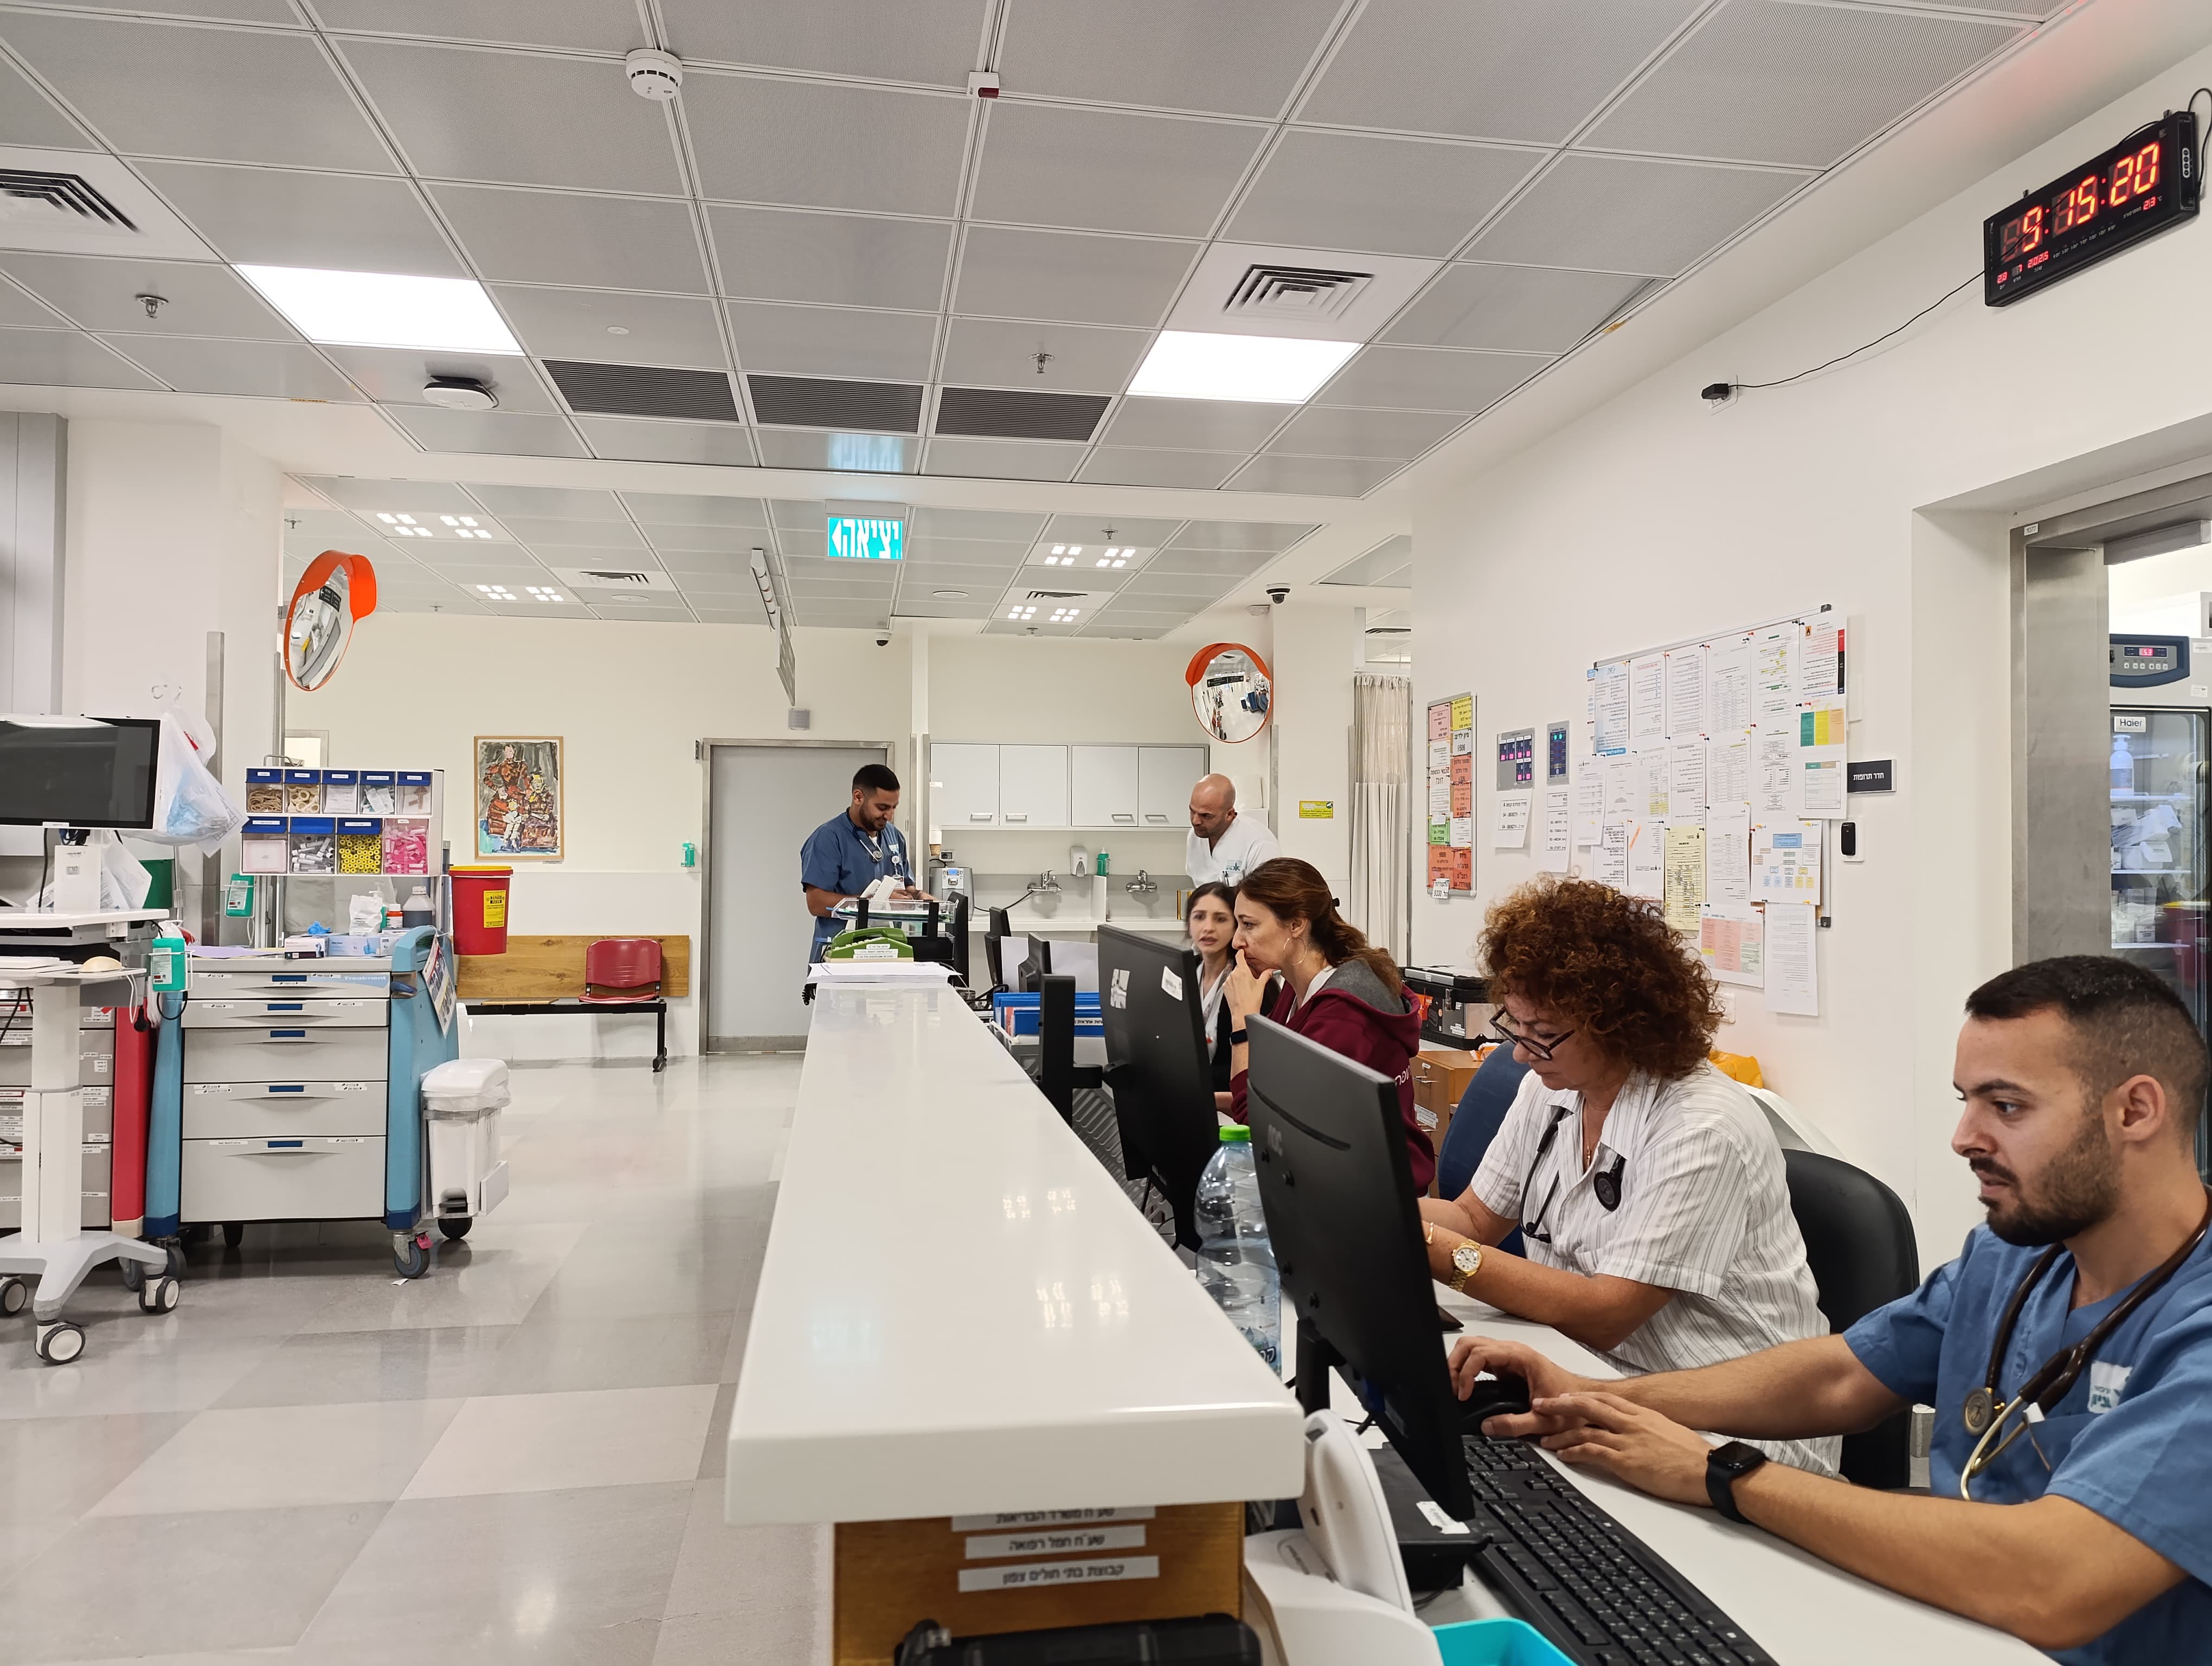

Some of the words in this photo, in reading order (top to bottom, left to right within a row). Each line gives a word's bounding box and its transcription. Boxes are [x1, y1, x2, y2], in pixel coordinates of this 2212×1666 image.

[2022, 143, 2160, 253] 9:15:20
[2028, 251, 2049, 268] 2025
[1997, 271, 2008, 284] 28
[842, 518, 899, 559] יציאה
[2120, 719, 2142, 727] Haier
